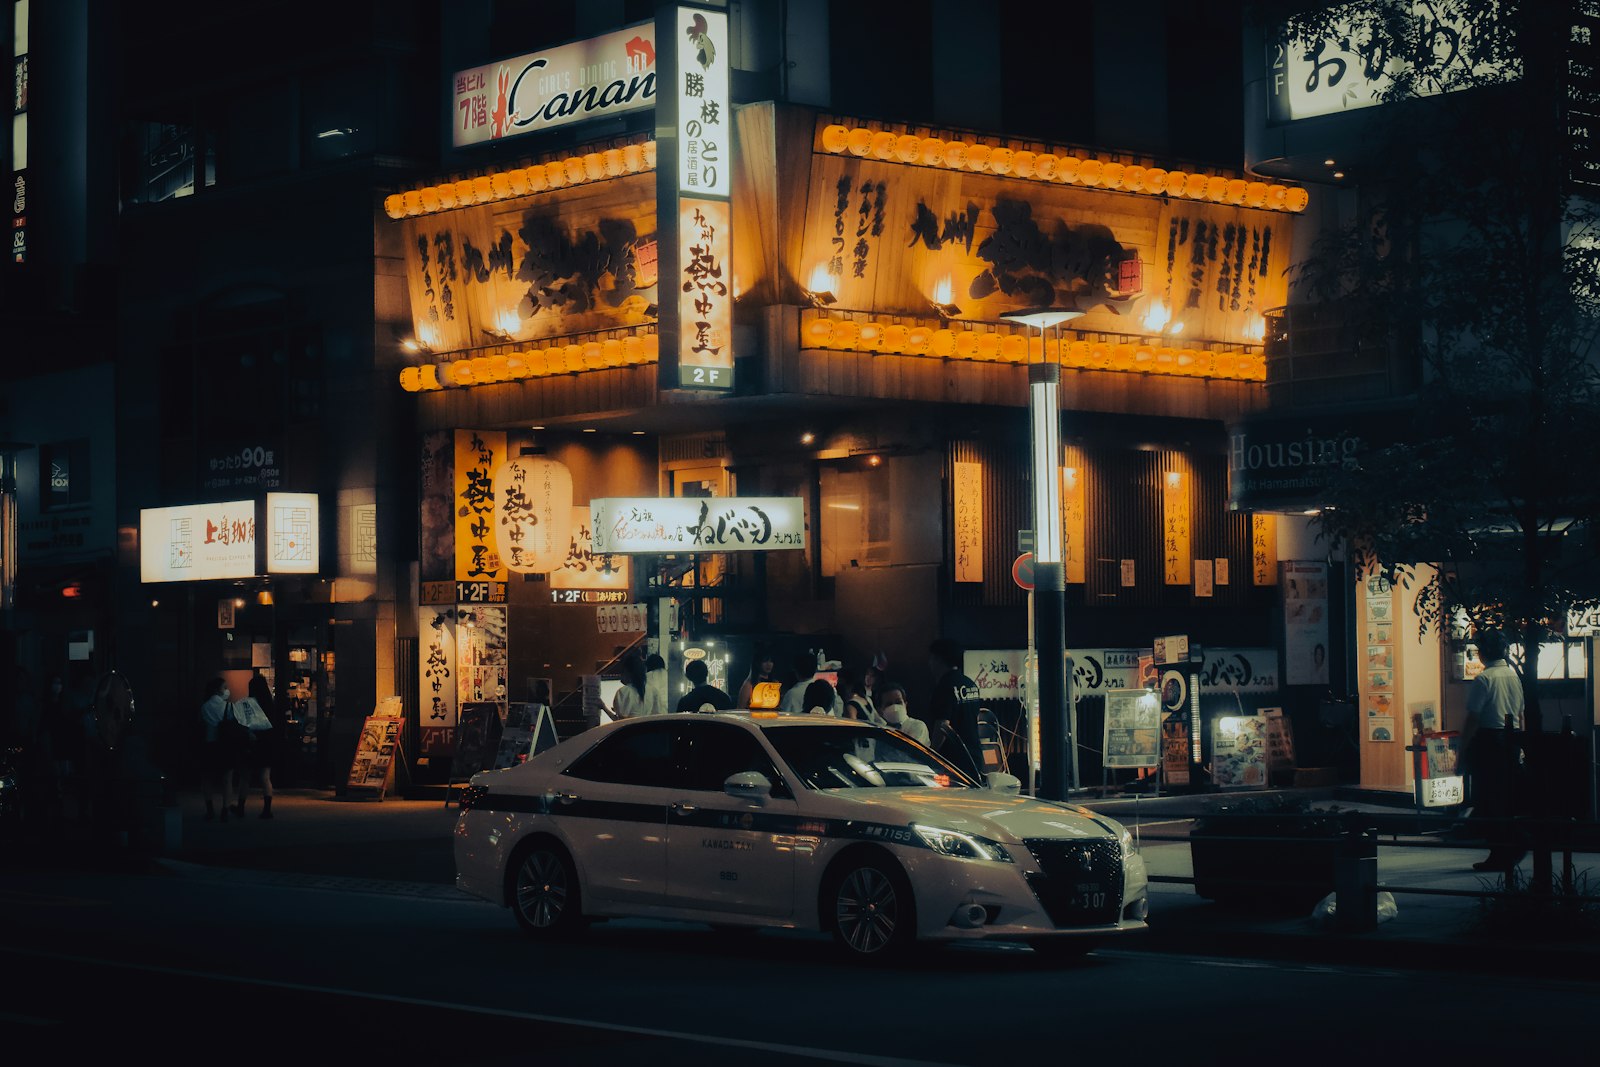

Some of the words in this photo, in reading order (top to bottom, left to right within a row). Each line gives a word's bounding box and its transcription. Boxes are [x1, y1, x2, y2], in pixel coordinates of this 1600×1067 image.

[456, 73, 486, 95] 当ビル
[538, 71, 571, 96] GIRL'S
[580, 60, 617, 87] DINING
[626, 52, 648, 75] BAR
[1272, 43, 1285, 96] 2F
[458, 94, 488, 131] 7階
[907, 197, 978, 257] 九州
[462, 228, 514, 284] 九州
[693, 367, 719, 384] 2F
[1230, 427, 1361, 472] Housing
[501, 461, 539, 568] 九州熱中屋
[629, 507, 654, 522] 元祖
[686, 499, 772, 547] ねじべえ
[773, 532, 802, 545] 大門店
[1104, 677, 1125, 688] 大門店
[440, 729, 454, 744] 1F
